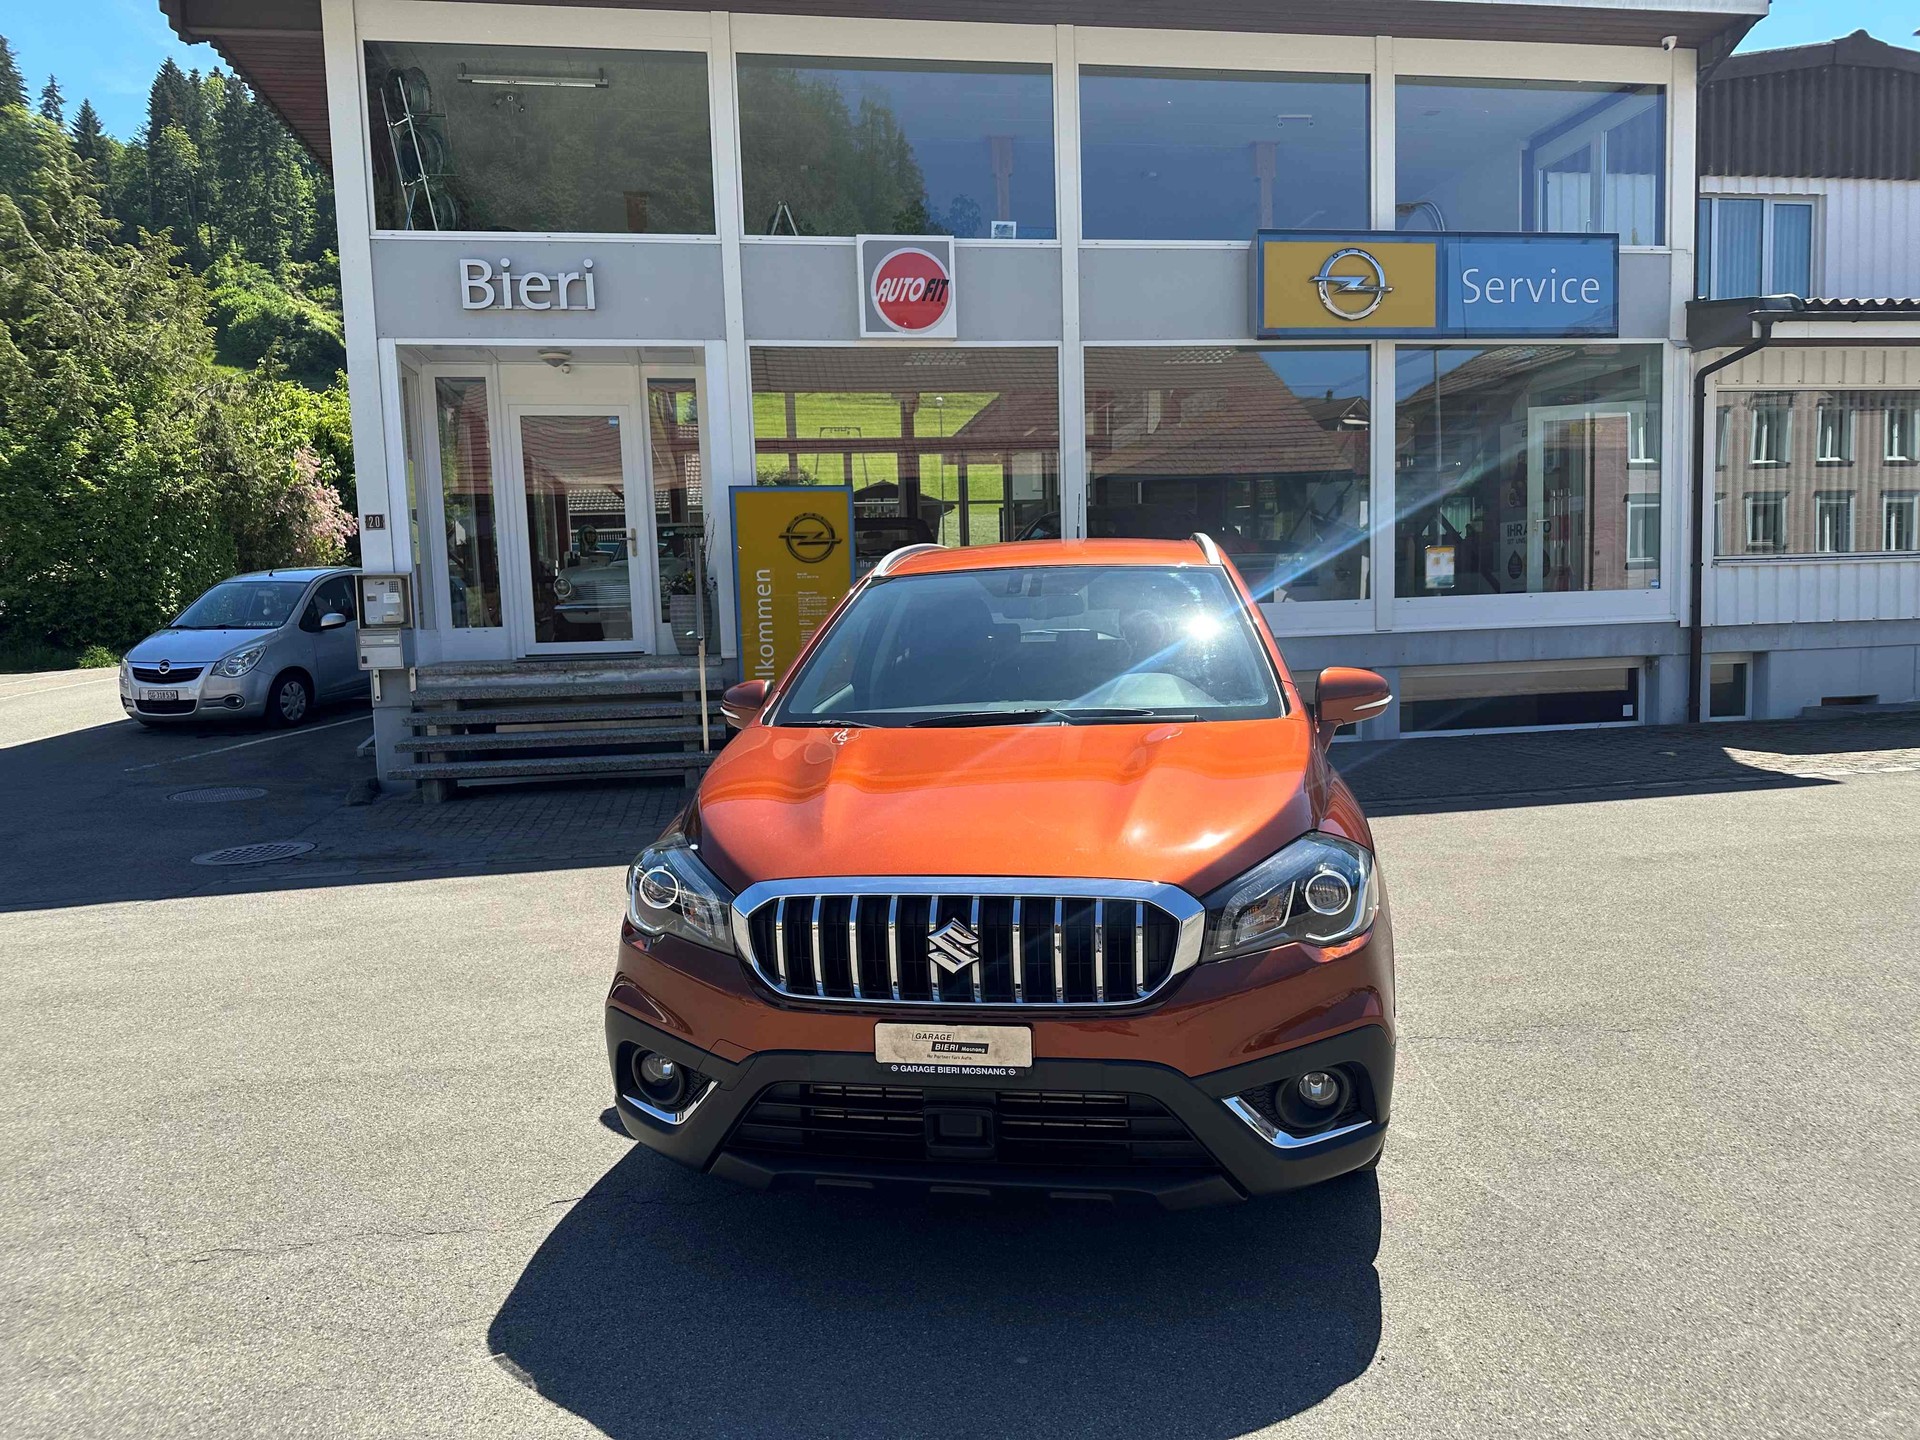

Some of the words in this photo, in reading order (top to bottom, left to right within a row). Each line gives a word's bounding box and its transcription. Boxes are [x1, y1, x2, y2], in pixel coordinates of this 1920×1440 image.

[459, 258, 596, 310] Bieri
[877, 277, 950, 303] AUTOFIT
[1461, 268, 1600, 305] Service
[368, 516, 380, 528] 20
[1507, 523, 1523, 537] IHR
[1523, 521, 1552, 536] AO
[859, 559, 872, 568] Ihr
[755, 569, 775, 680] lkommen
[915, 1033, 952, 1041] GARAGE
[935, 1043, 959, 1052] BIERI
[901, 1065, 936, 1073] GARAGE
[938, 1066, 960, 1074] BIERI
[962, 1067, 1006, 1076] MOSNANG
